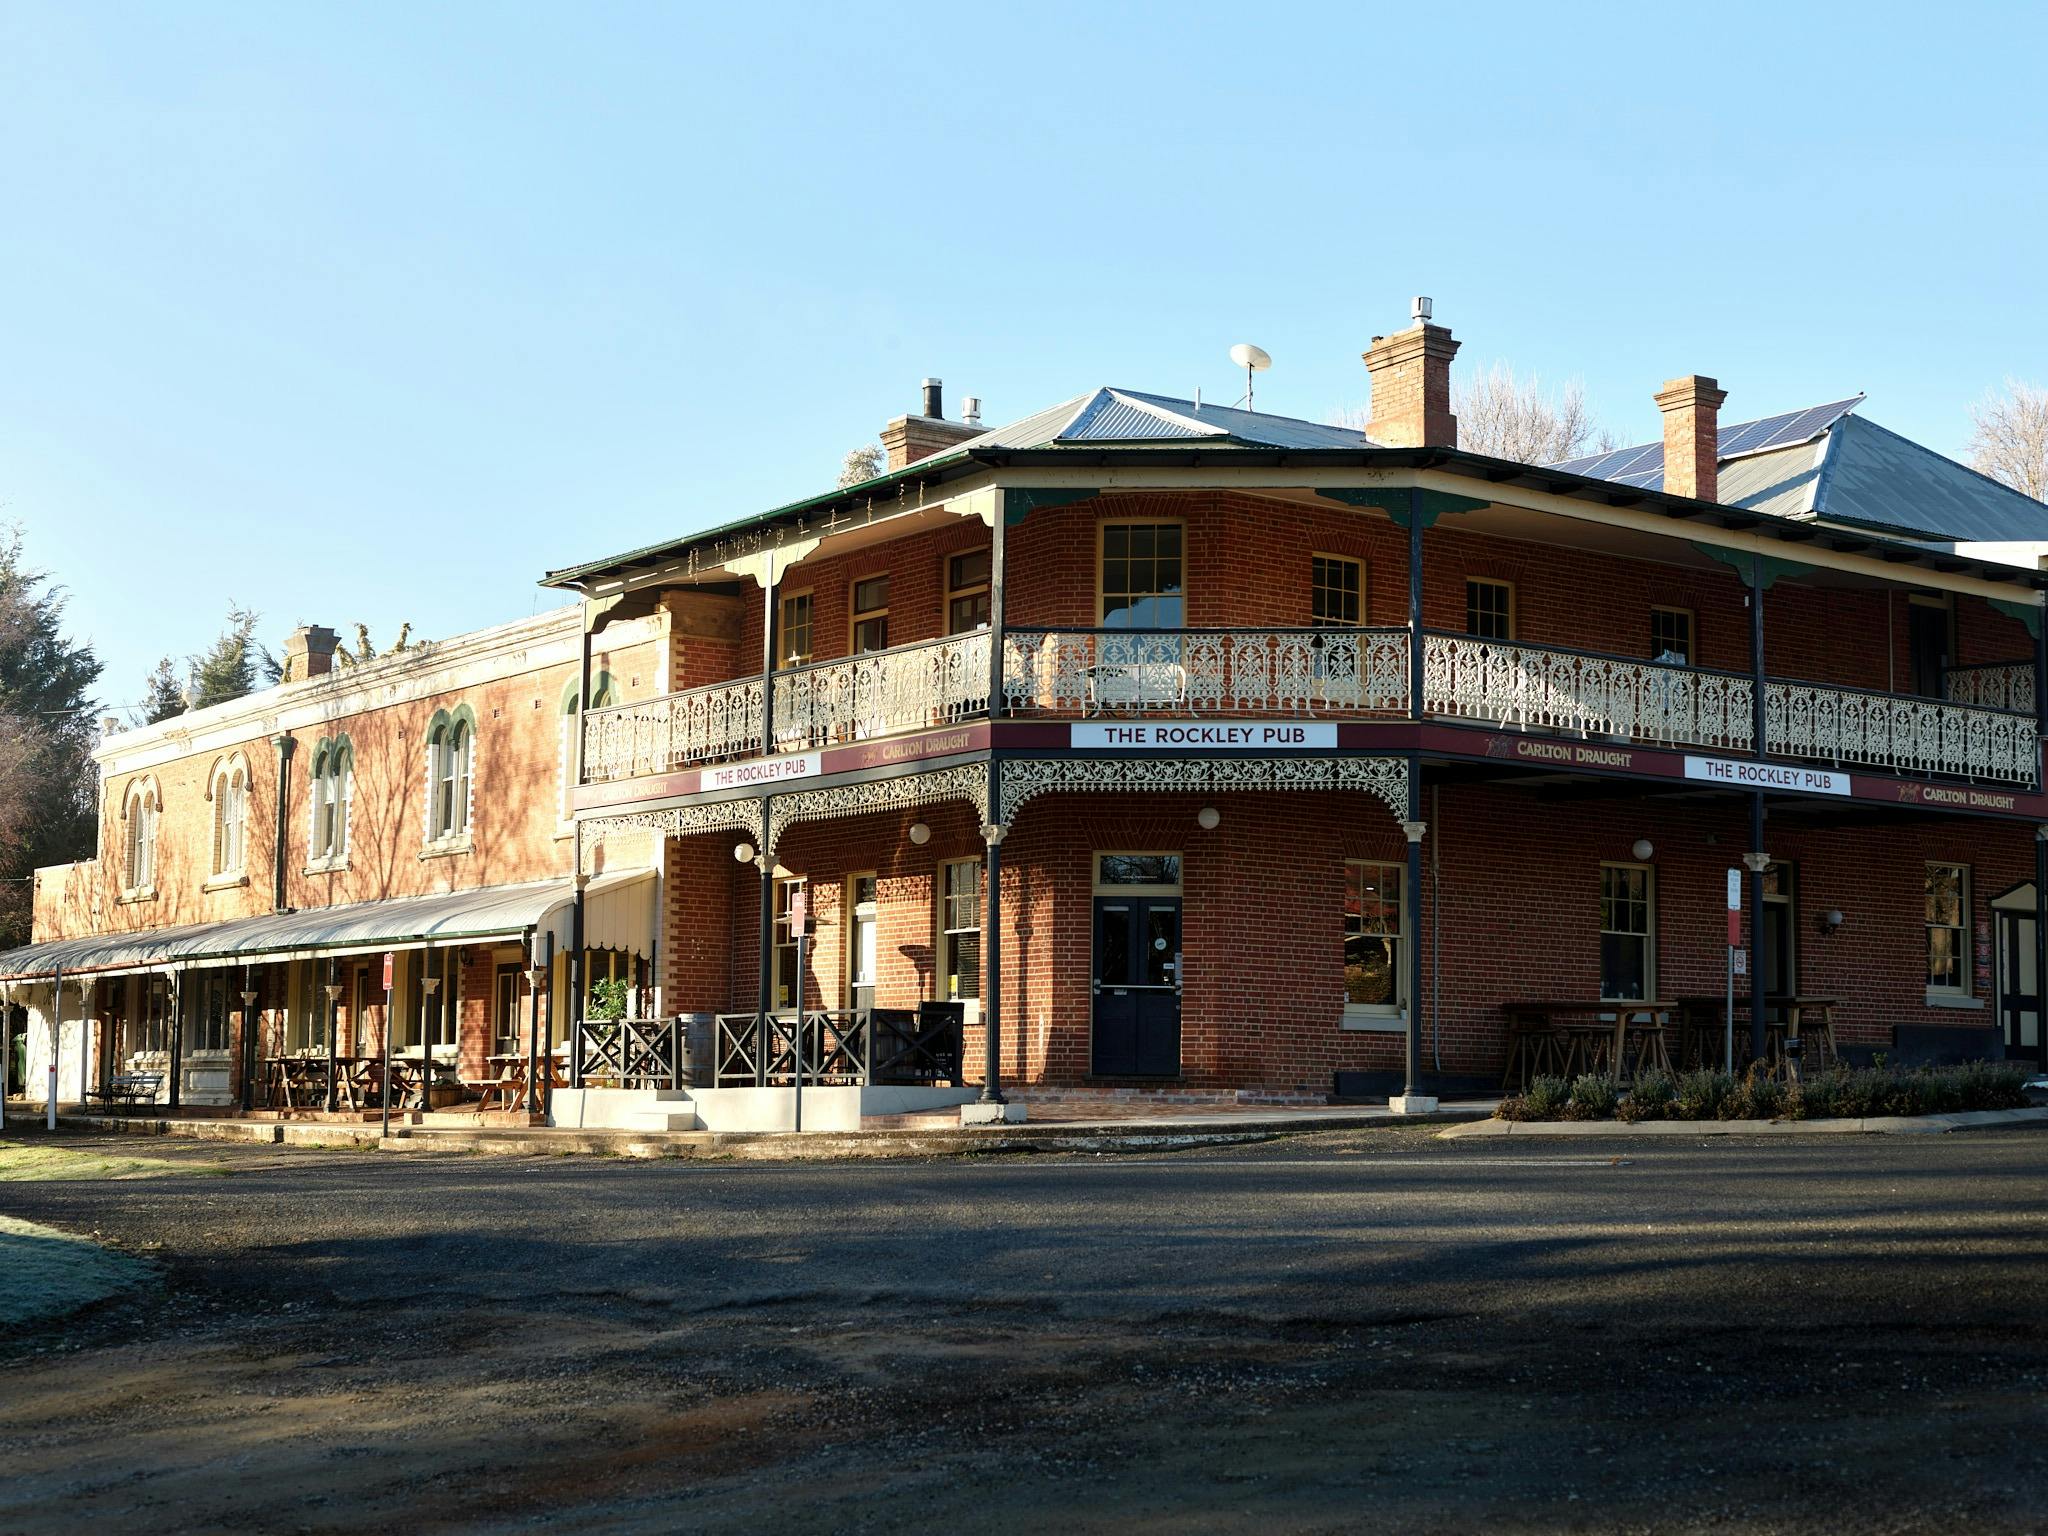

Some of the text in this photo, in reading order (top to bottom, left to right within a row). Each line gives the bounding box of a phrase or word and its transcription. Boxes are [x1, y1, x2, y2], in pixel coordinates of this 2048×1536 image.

[883, 733, 970, 760] CARLTON DRAUGHT
[1105, 728, 1305, 743] THE ROCKLEY PUB
[1517, 741, 1632, 767] CARLTON DRAUGHT
[715, 759, 806, 785] THE ROCKLEY PUB
[1706, 761, 1832, 789] THE ROCKLEY PUB
[634, 781, 668, 797] DRAUGHT
[1923, 787, 2015, 809] CARLTON DRAUGHT
